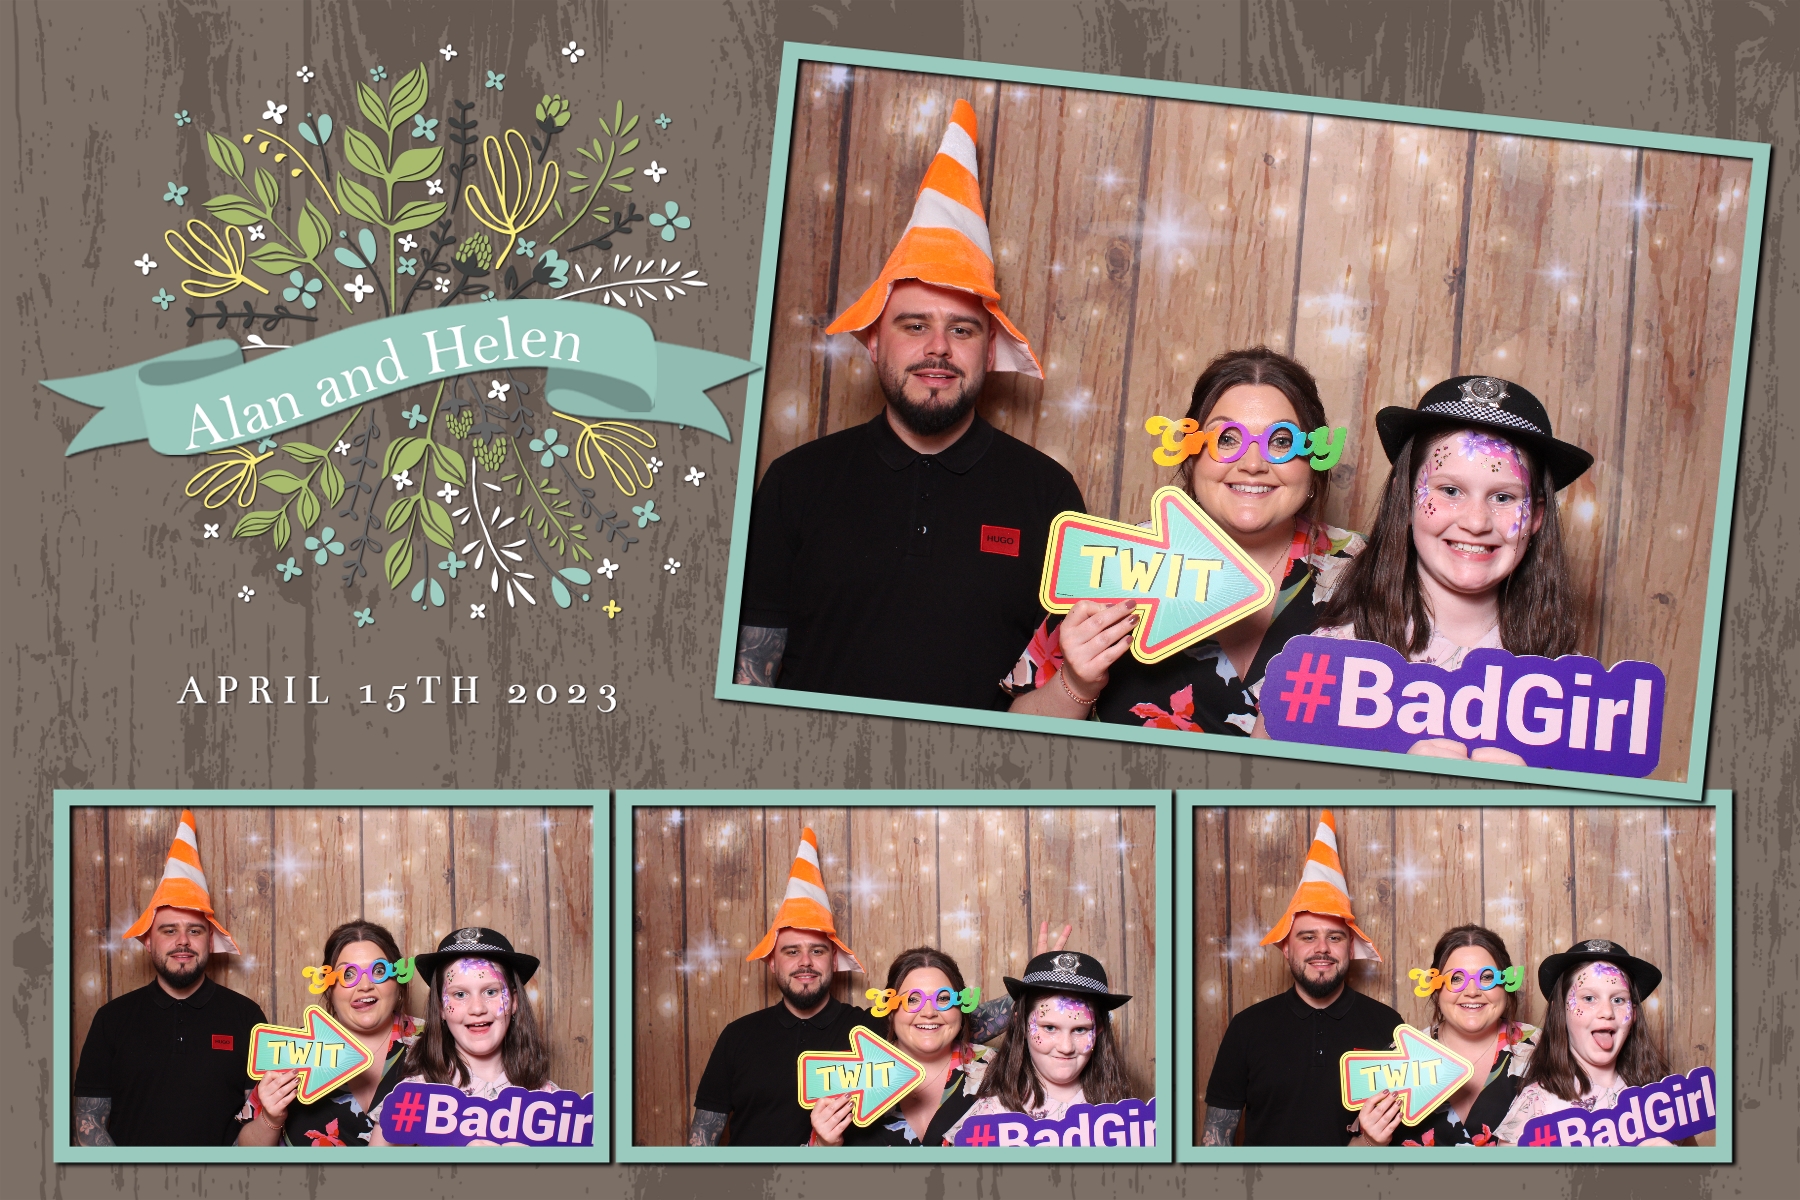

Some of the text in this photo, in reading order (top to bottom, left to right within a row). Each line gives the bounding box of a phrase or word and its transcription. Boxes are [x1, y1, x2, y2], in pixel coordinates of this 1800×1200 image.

[987, 534, 1014, 545] HUGO
[1080, 544, 1224, 603] TWIT
[1280, 652, 1652, 755] #BadGirl
[267, 1040, 346, 1069] TWIT
[815, 1060, 896, 1092] TWIT
[1359, 1058, 1442, 1092] TWIT
[391, 1091, 594, 1145] #BadGir
